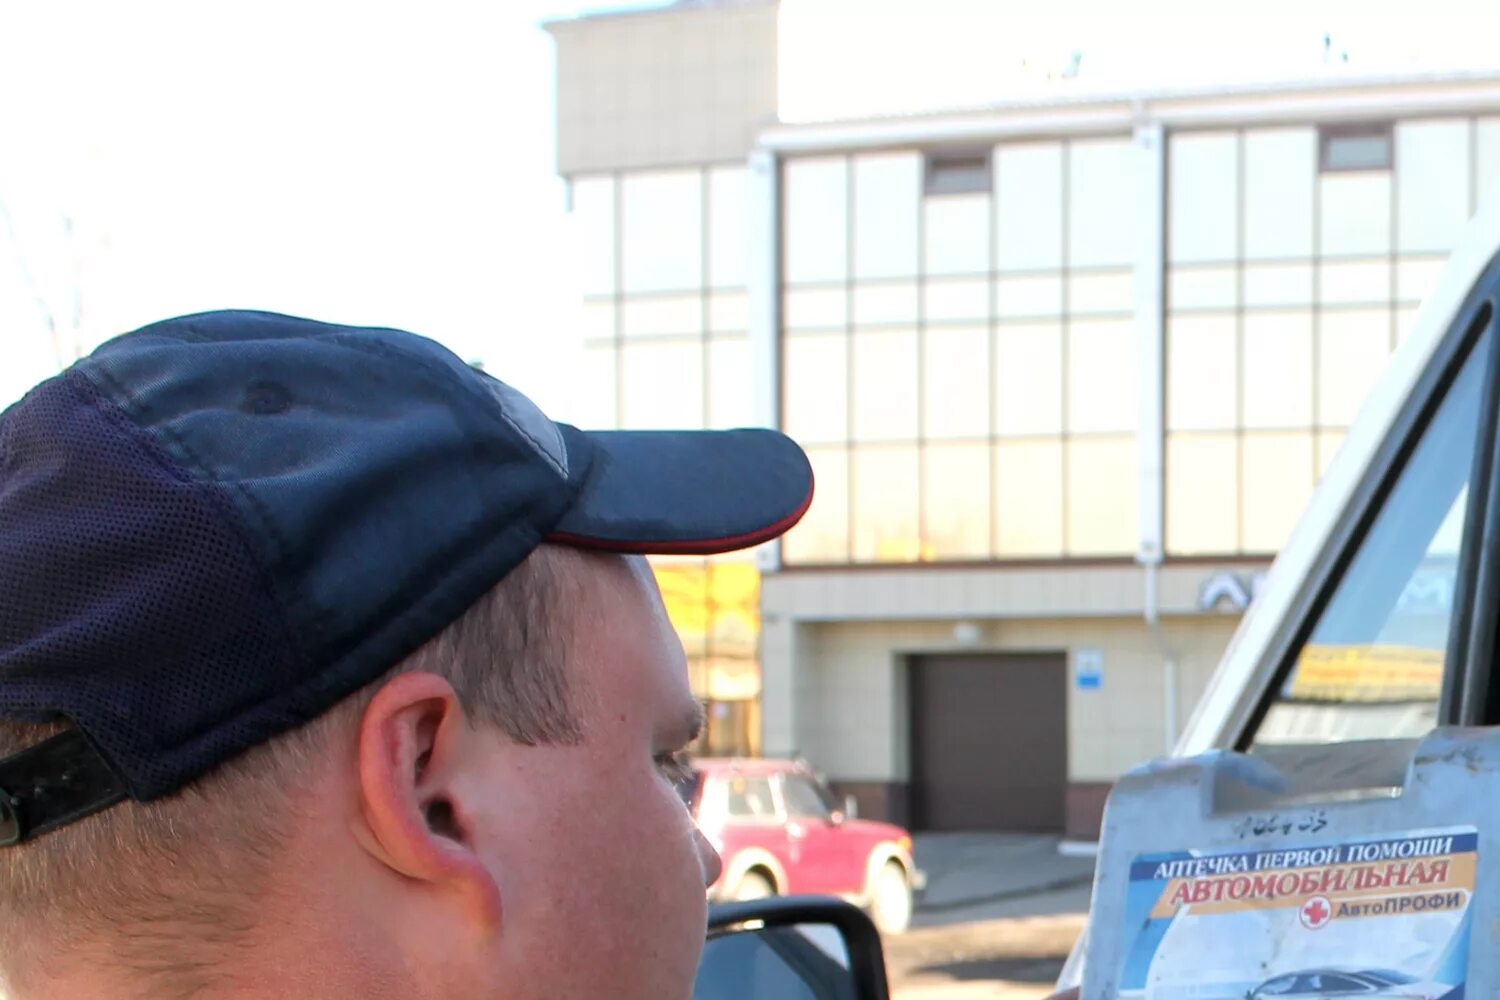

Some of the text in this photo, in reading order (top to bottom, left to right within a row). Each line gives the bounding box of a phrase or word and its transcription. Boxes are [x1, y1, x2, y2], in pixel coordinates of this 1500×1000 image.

[1153, 855, 1249, 879] АПТЕЧКА
[1346, 836, 1453, 862] ПОМОЩИ
[1170, 858, 1451, 905] АВТОМОБИЛЬНАЯ
[1337, 892, 1460, 918] АвтоПРОФИ
